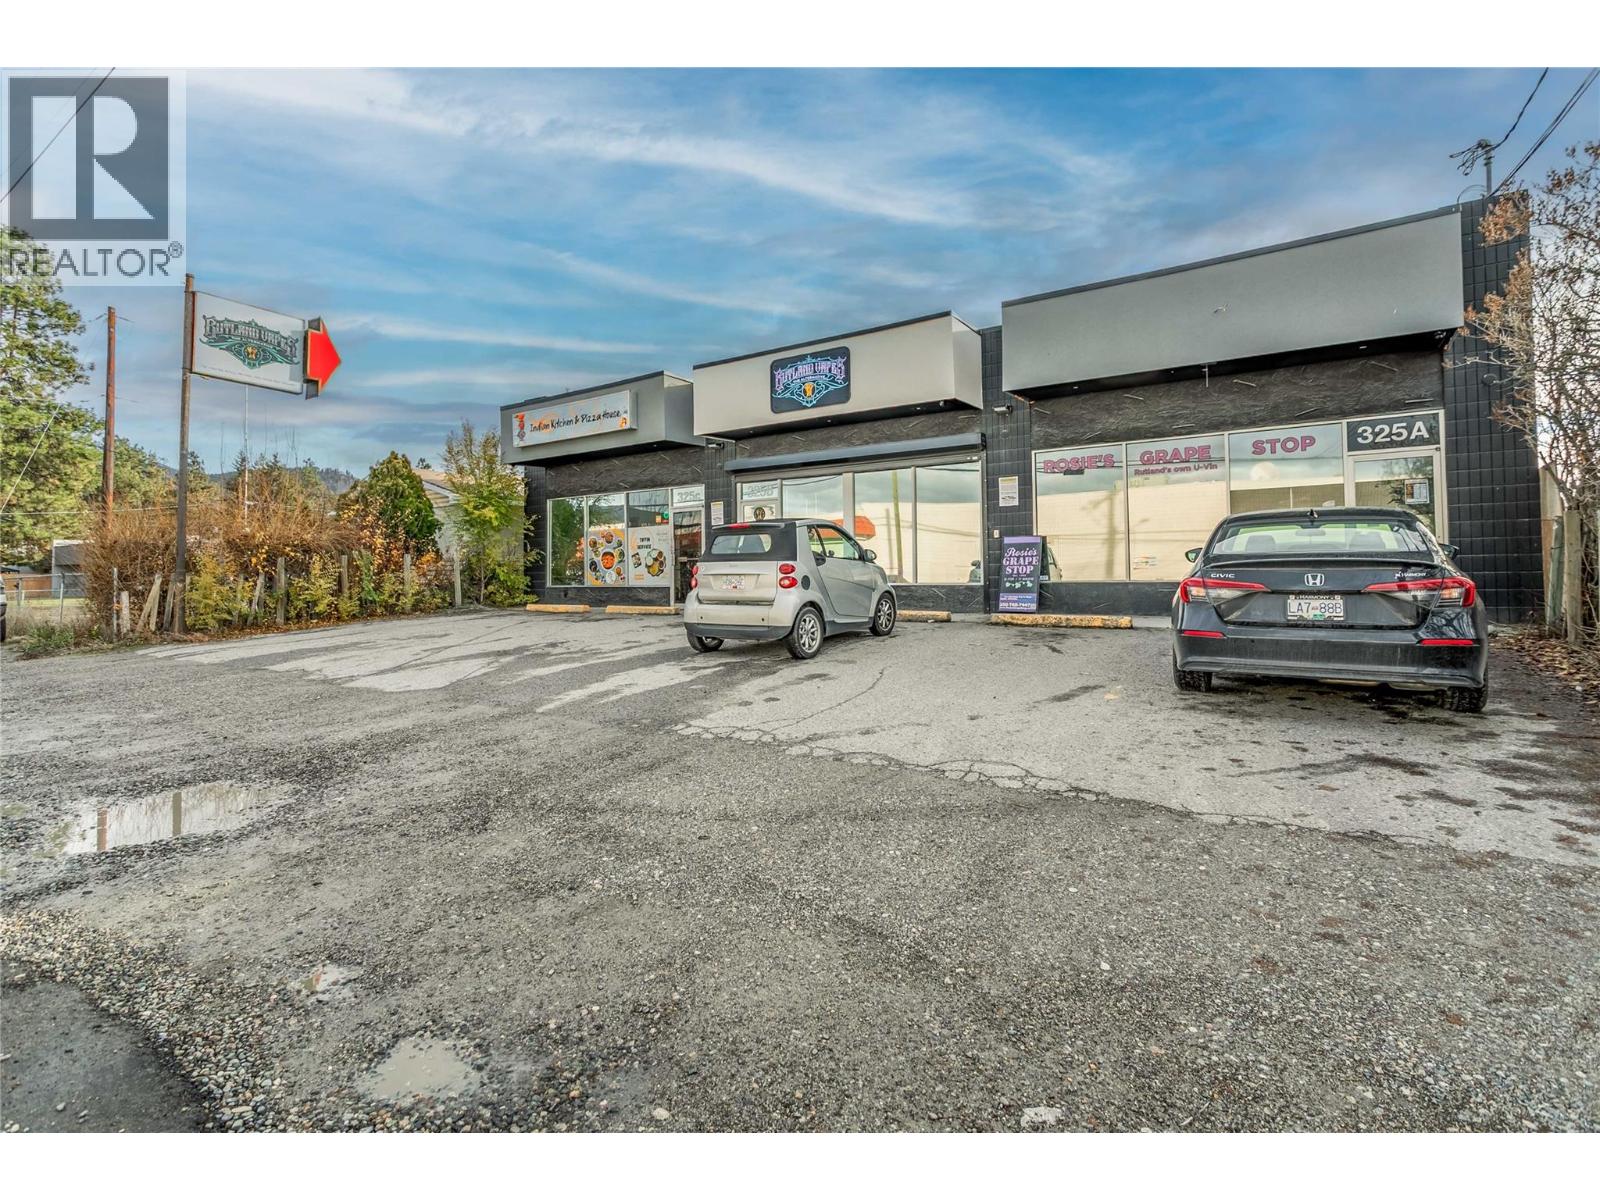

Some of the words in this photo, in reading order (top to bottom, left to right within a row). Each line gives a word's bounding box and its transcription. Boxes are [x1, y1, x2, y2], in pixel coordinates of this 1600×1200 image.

[774, 361, 814, 392] RUTLAND
[529, 421, 550, 432] Indian
[551, 418, 573, 429] Kitchen
[575, 415, 580, 424] &
[581, 413, 601, 423] Pizza
[602, 410, 620, 420] House
[1356, 421, 1430, 444] 325A
[1140, 445, 1211, 465] GRAPE
[1252, 436, 1316, 455] STOP
[1043, 453, 1115, 473] ROSIE'S
[1134, 466, 1171, 476] Rutland's
[1173, 465, 1191, 473] own
[1003, 556, 1039, 565] GRAPE
[1004, 547, 1037, 557] Rosie's
[1006, 565, 1034, 574] STOP
